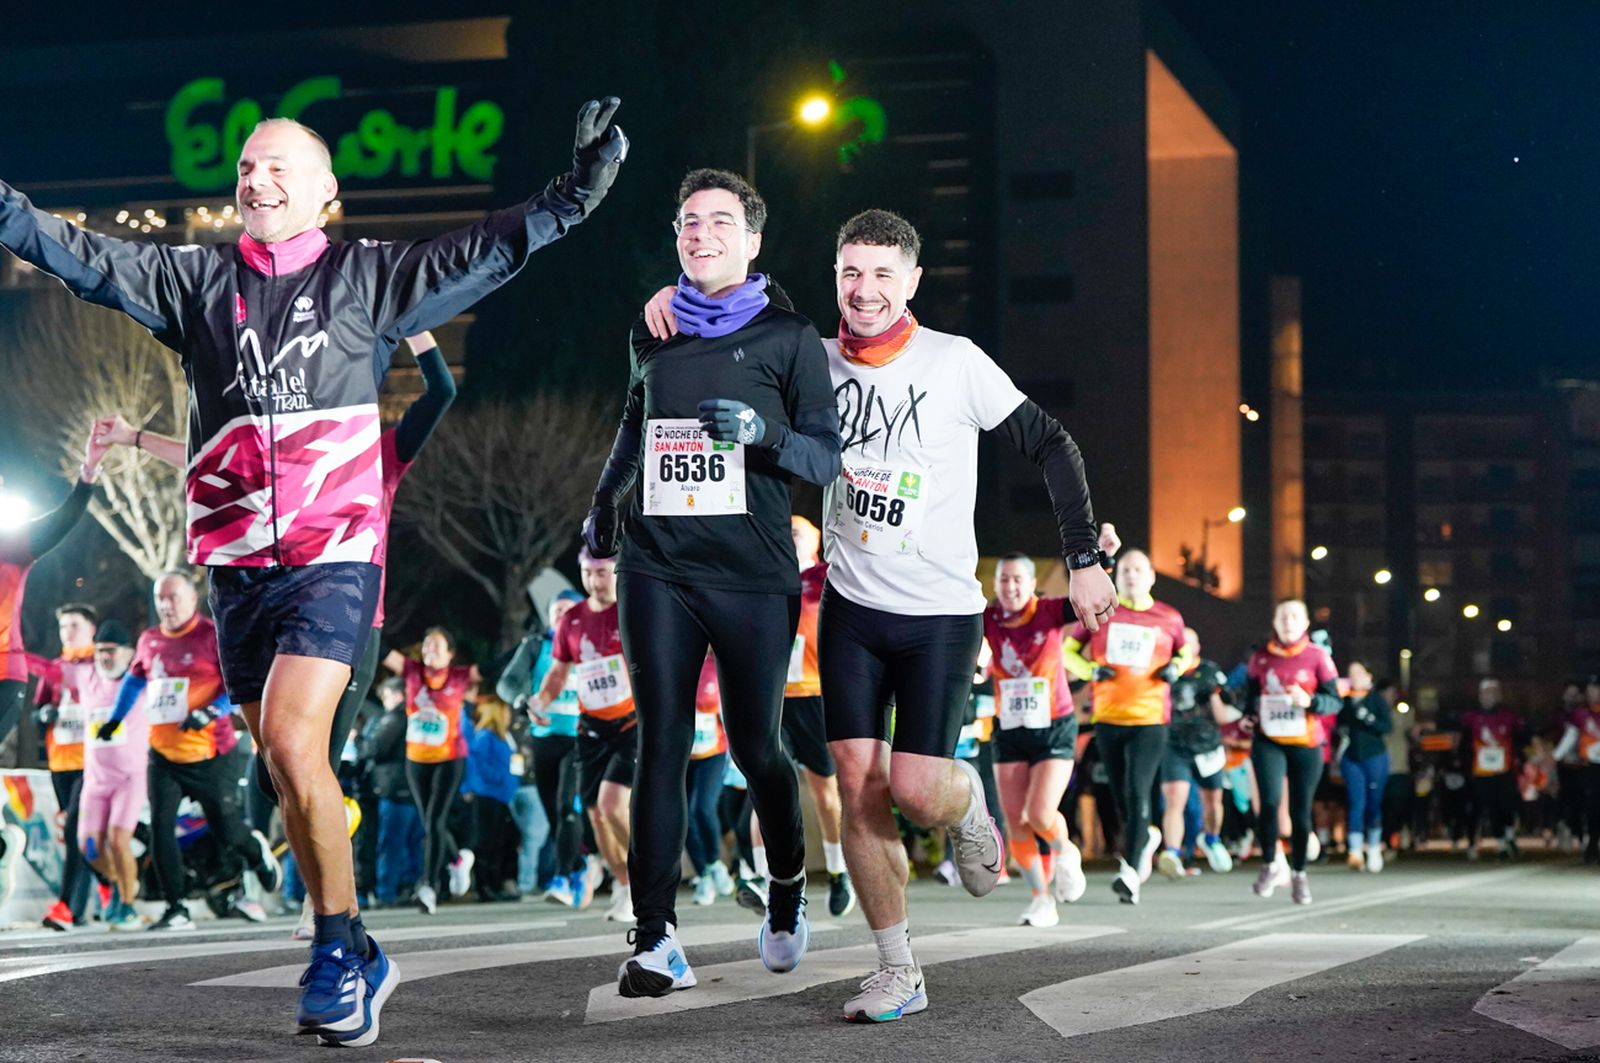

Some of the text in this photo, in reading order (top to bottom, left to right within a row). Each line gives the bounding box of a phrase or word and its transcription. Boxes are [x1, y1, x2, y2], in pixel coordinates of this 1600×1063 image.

[272, 394, 313, 411] TRAIL
[664, 430, 691, 439] NOCHE
[693, 430, 703, 439] DE
[655, 441, 671, 452] SAN
[660, 453, 725, 482] 6536
[854, 469, 880, 481] NOCHE
[880, 473, 892, 481] DE
[846, 482, 905, 527] 6058
[587, 674, 618, 692] 1489
